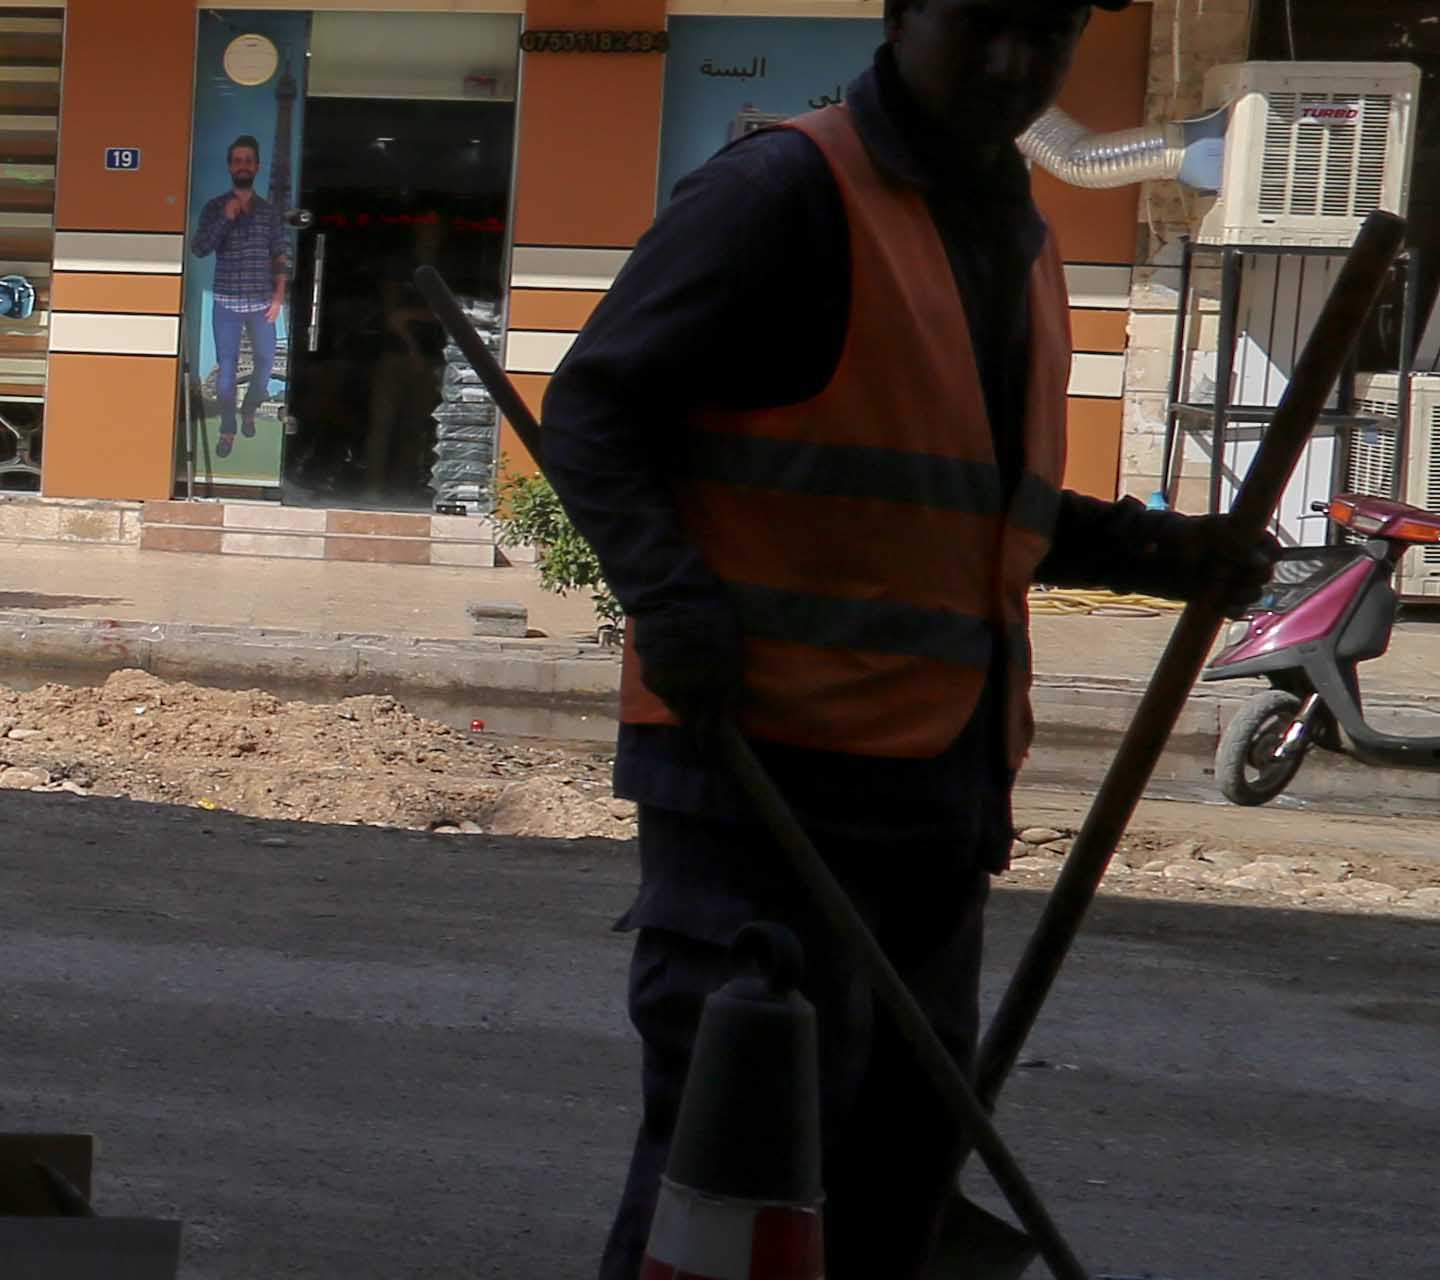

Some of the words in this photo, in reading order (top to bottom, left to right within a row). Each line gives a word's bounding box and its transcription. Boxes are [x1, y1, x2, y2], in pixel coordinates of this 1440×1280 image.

[700, 57, 767, 81] البسة
[1301, 108, 1359, 118] TURBO
[111, 149, 134, 169] 19
